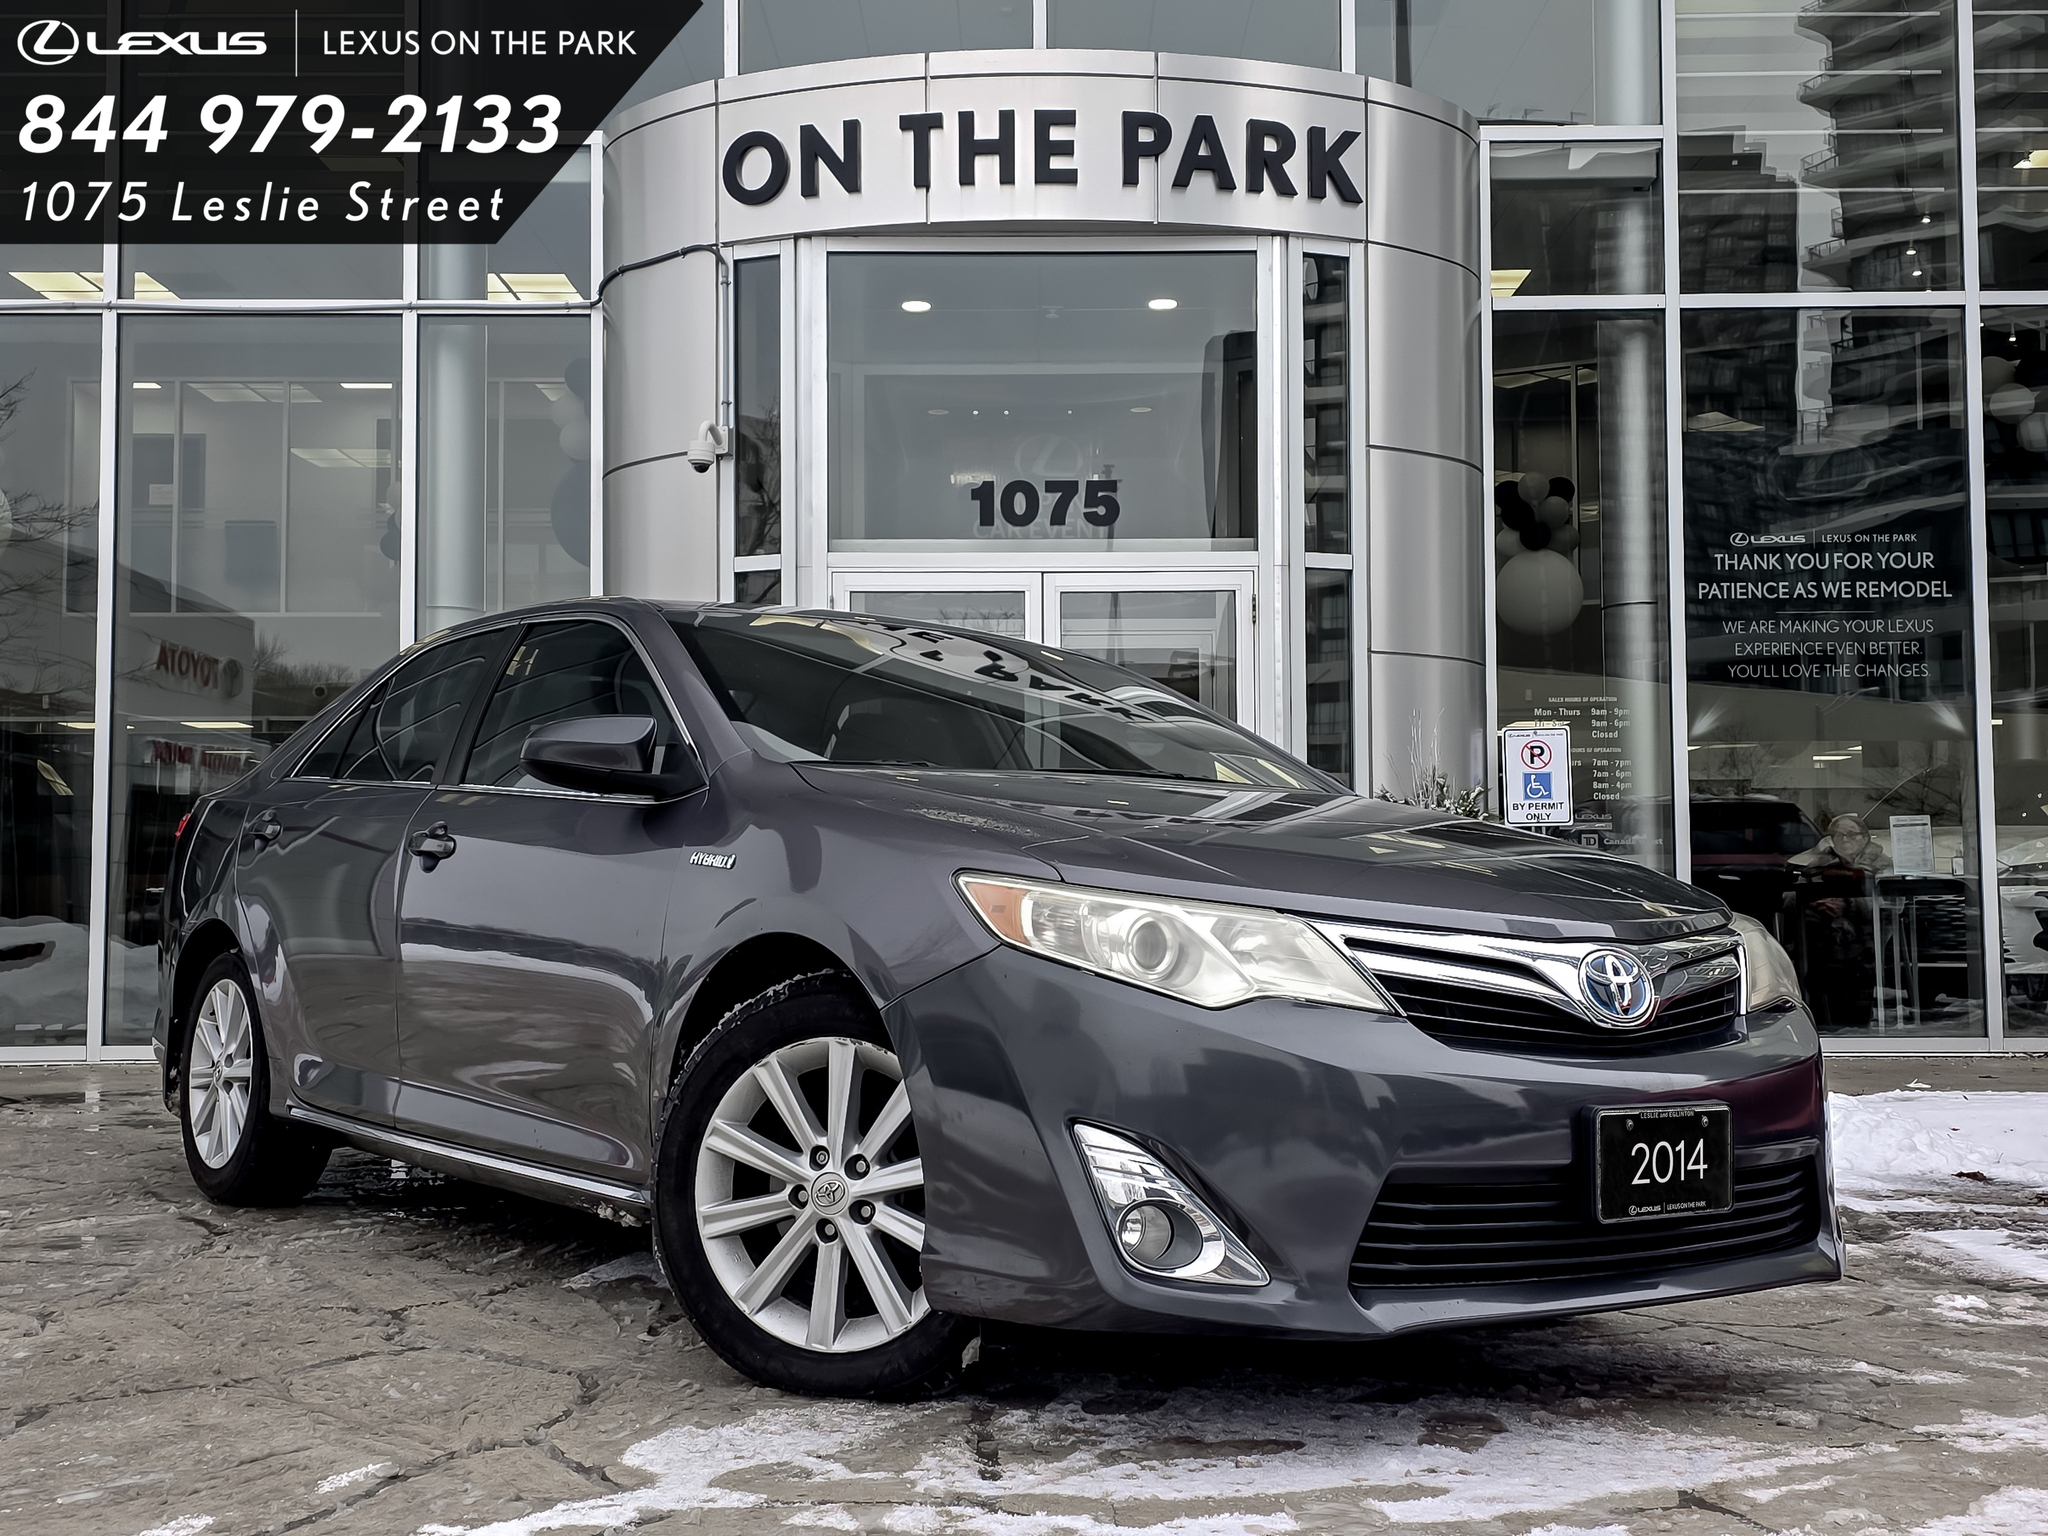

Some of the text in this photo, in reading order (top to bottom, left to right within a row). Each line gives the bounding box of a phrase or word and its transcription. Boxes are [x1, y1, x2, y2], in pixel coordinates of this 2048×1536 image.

[722, 109, 1364, 205] ON THE PARK
[971, 480, 1120, 527] 1075
[1750, 535, 1806, 544] LEXUS
[1821, 533, 1917, 543] LEXUS ON THE PARK
[1714, 552, 1934, 570] THANK YOU FOR YOUR
[1698, 581, 1953, 599] PATIENCE AS WE REMODEL
[1722, 619, 1934, 633] WE ARE MAKING YOUR LEXUS
[1735, 641, 1923, 656] EXPERIENCE EVEN BETTER.
[1727, 664, 1931, 678] YOU'LL LOVE THE CHANGES.
[1534, 708, 1552, 716] Mon
[1558, 708, 1581, 716] Thurs
[1591, 707, 1607, 715] 9am
[1613, 707, 1631, 717] 9pm
[1591, 719, 1608, 727] 9am
[1614, 719, 1631, 728] 6pm
[1591, 730, 1619, 738] Closed
[1614, 759, 1632, 767] 7pm
[1615, 770, 1632, 779] 6pm
[1616, 781, 1632, 790] 4pm
[1593, 792, 1620, 800] Closed
[1512, 802, 1564, 811] BY PERMIT
[1525, 813, 1551, 821] ONLY
[1631, 1138, 1708, 1185] 2014
